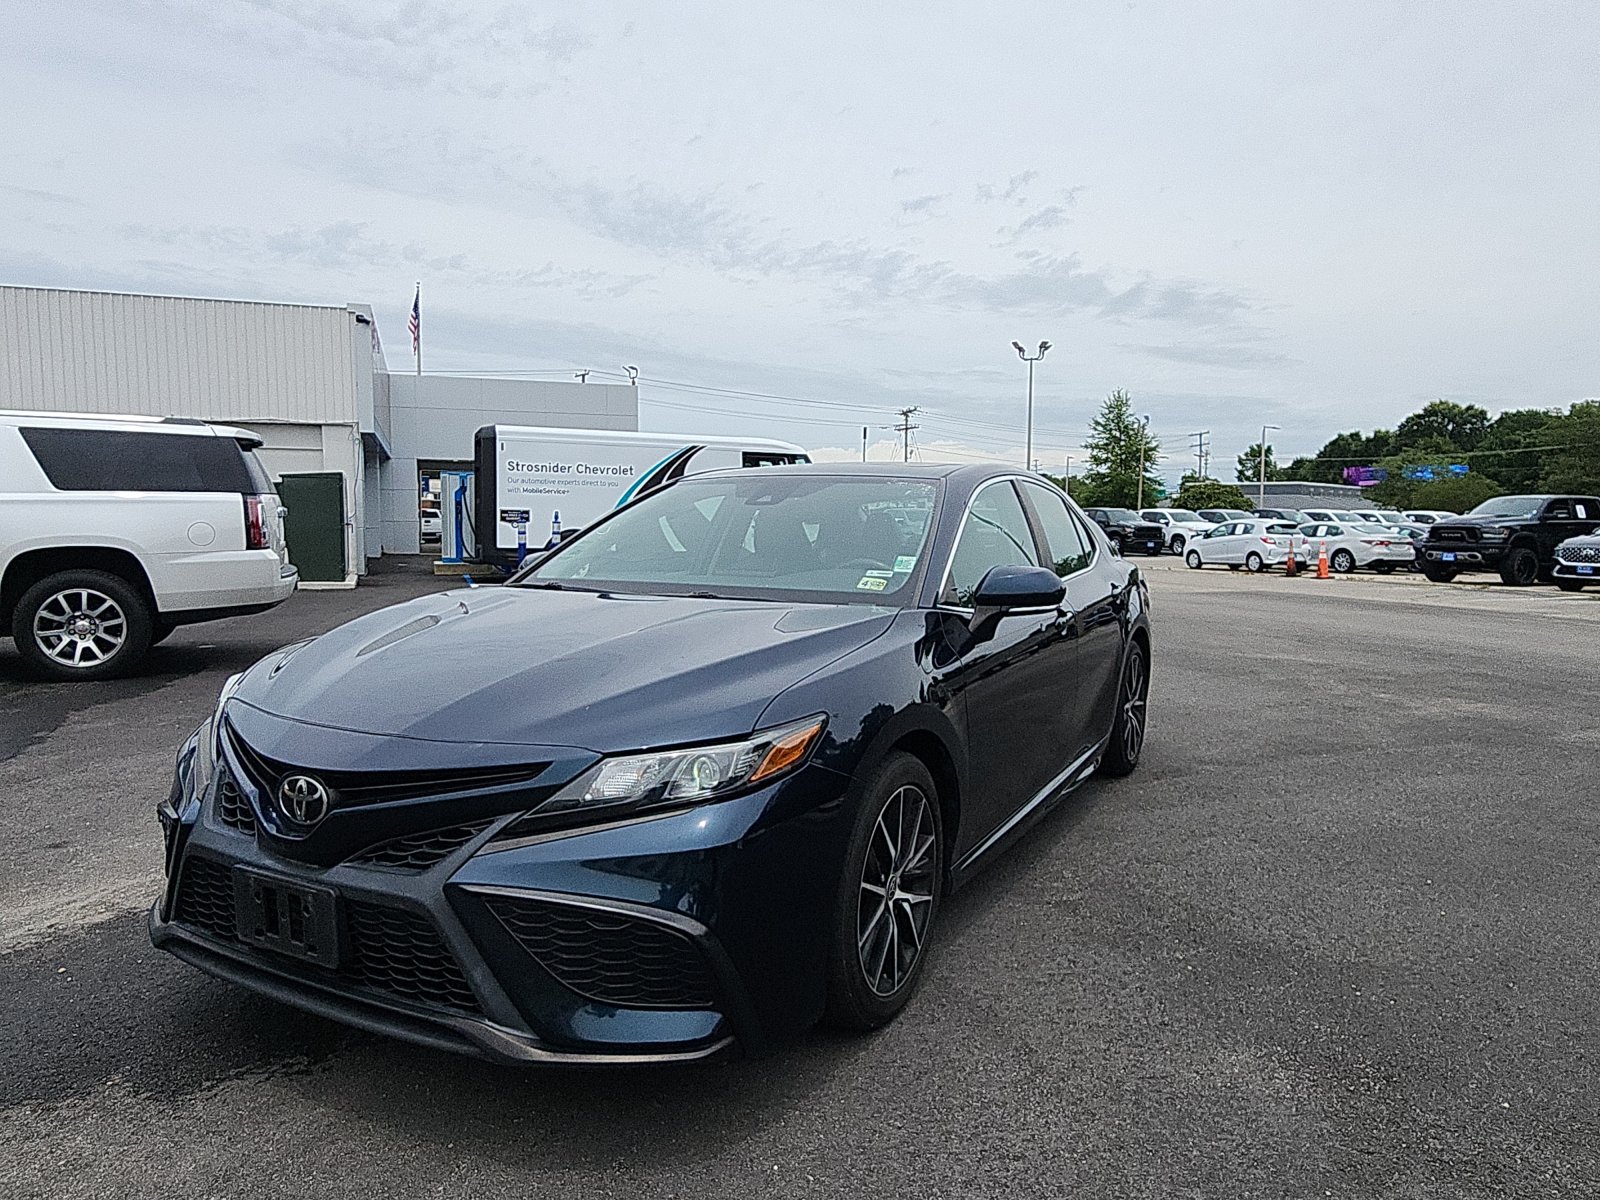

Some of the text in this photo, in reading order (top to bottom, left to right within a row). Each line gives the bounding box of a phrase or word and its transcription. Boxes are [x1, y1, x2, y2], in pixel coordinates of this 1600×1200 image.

[507, 461, 634, 476] Strosnider Chevrolet
[557, 479, 580, 487] experts
[581, 479, 599, 487] direct
